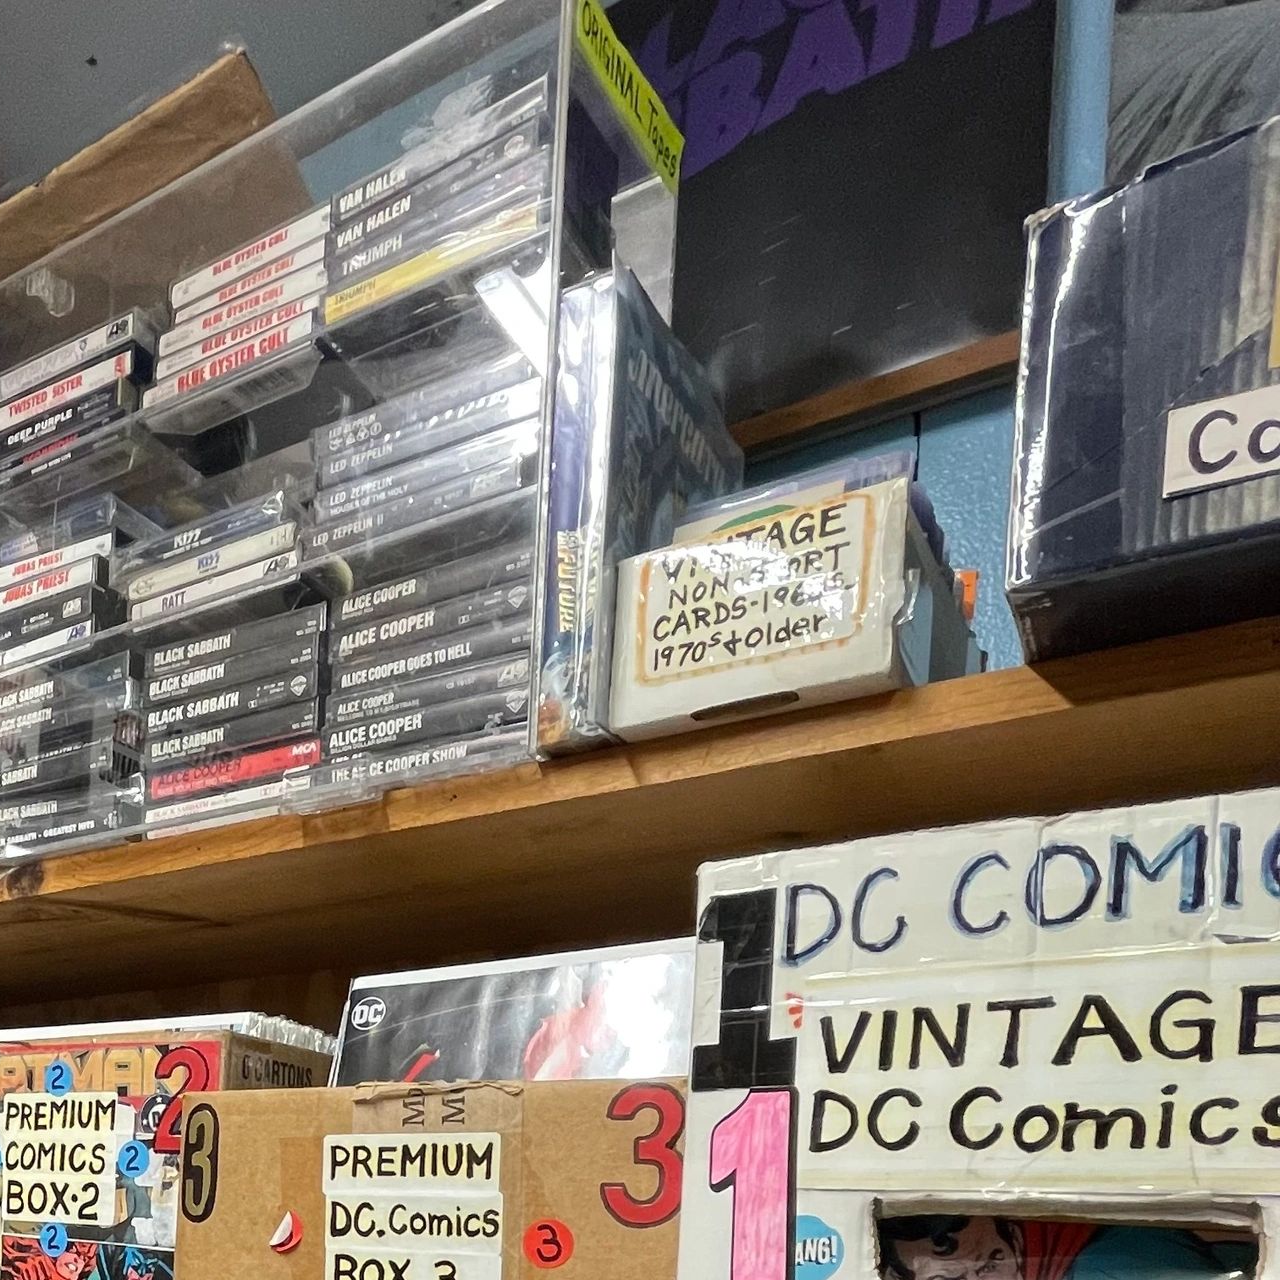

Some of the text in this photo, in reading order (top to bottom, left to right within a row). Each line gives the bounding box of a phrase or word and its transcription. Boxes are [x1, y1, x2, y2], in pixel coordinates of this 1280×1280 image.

[645, 97, 678, 180] Tapes
[336, 195, 412, 250] VAN HALEN
[340, 234, 403, 276] TRIUMPH
[177, 367, 206, 393] BLUE
[259, 326, 290, 357] CULT
[8, 374, 84, 418] TWISTED SISTER
[7, 407, 73, 446] DEEP PURPLE
[350, 475, 394, 500] ZEPPELIN
[2, 570, 70, 605] JUDAS PRIEST
[339, 611, 435, 658] ALICE COOPER
[341, 641, 473, 689] ALICE COOPER GOES TO HELL
[148, 692, 240, 730] BLACK SABBATH
[781, 866, 907, 967] DC
[352, 1000, 384, 1023] DC
[692, 887, 798, 1091] 1
[819, 984, 1280, 1075] VINTAGE
[256, 1053, 313, 1088] CARTONS
[5, 1099, 117, 1132] PREMIUM
[153, 1045, 211, 1154] 2
[810, 1083, 1280, 1154] DC Comics
[5, 1141, 107, 1174] COMICS
[183, 1102, 219, 1224] 3
[269, 1142, 495, 1181] PREMIUM
[600, 1082, 687, 1228] 3
